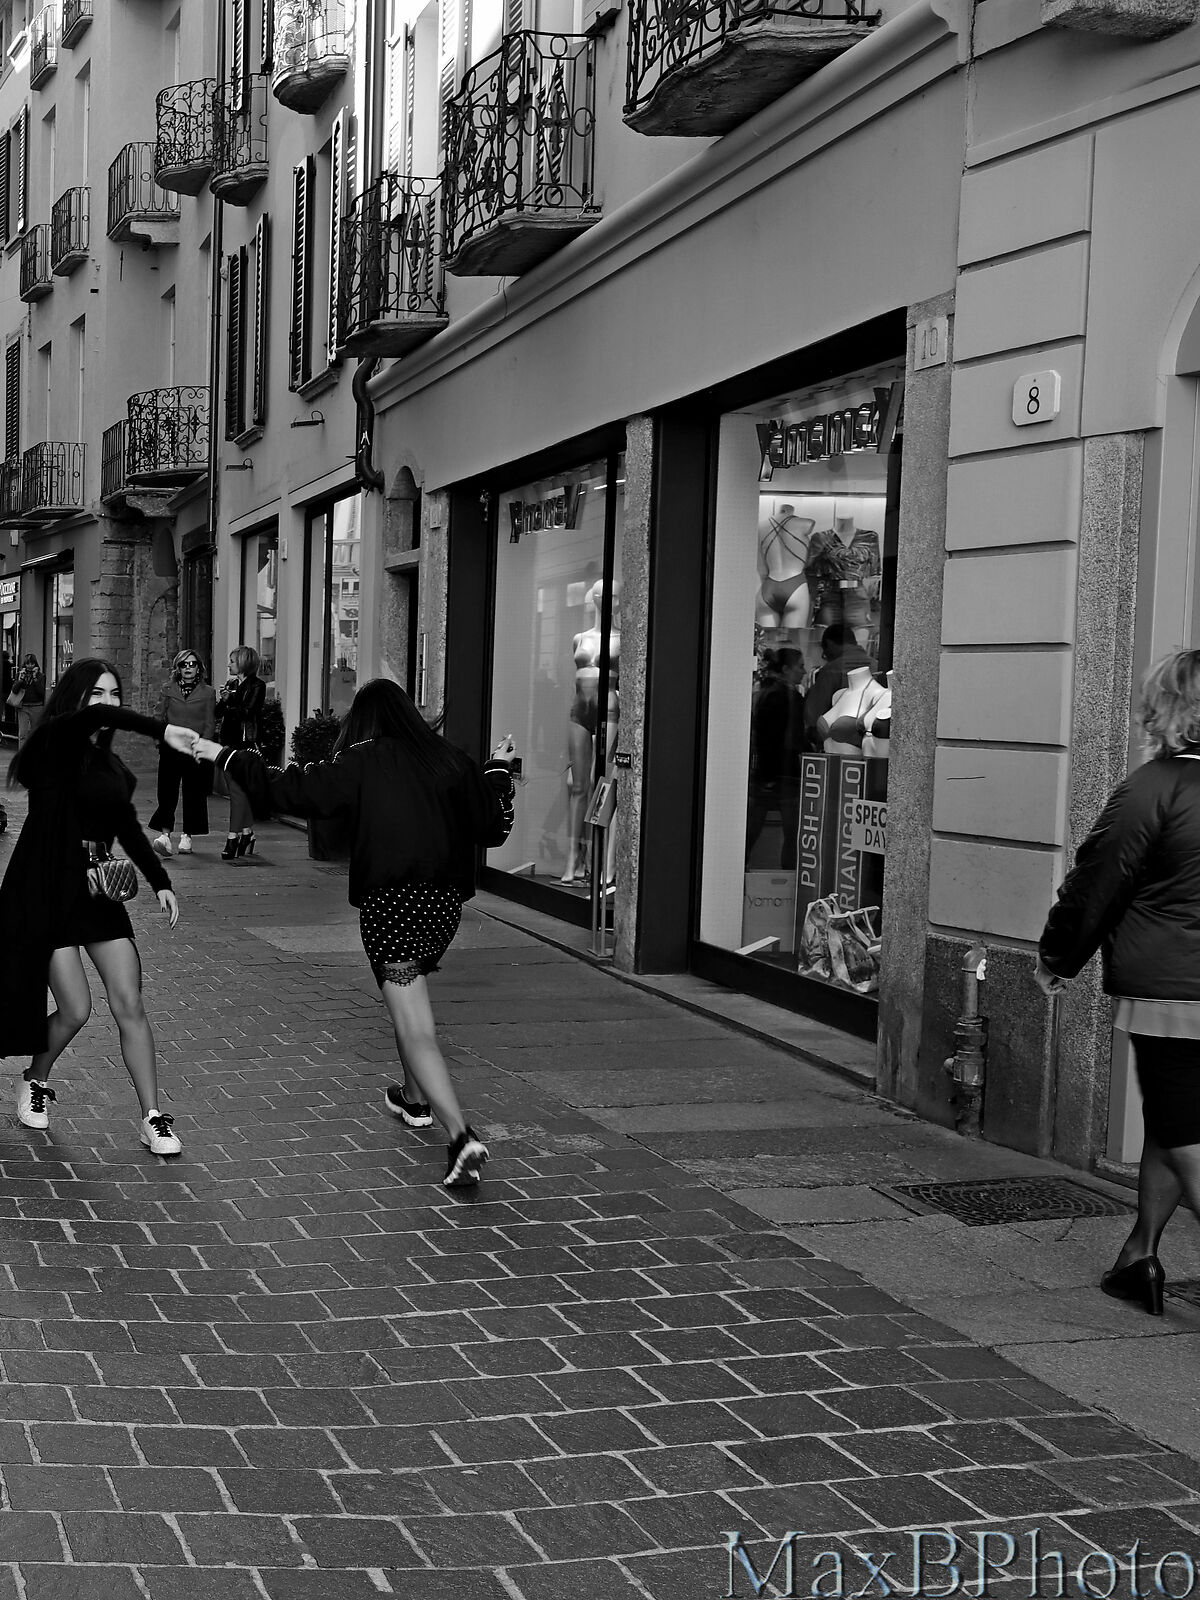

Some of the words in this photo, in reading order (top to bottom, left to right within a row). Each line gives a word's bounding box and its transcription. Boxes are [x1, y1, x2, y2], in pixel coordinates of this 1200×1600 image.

[921, 326, 939, 361] 10
[1026, 385, 1041, 415] 8
[800, 762, 822, 888] PUSH-UP
[855, 803, 887, 828] SPEC
